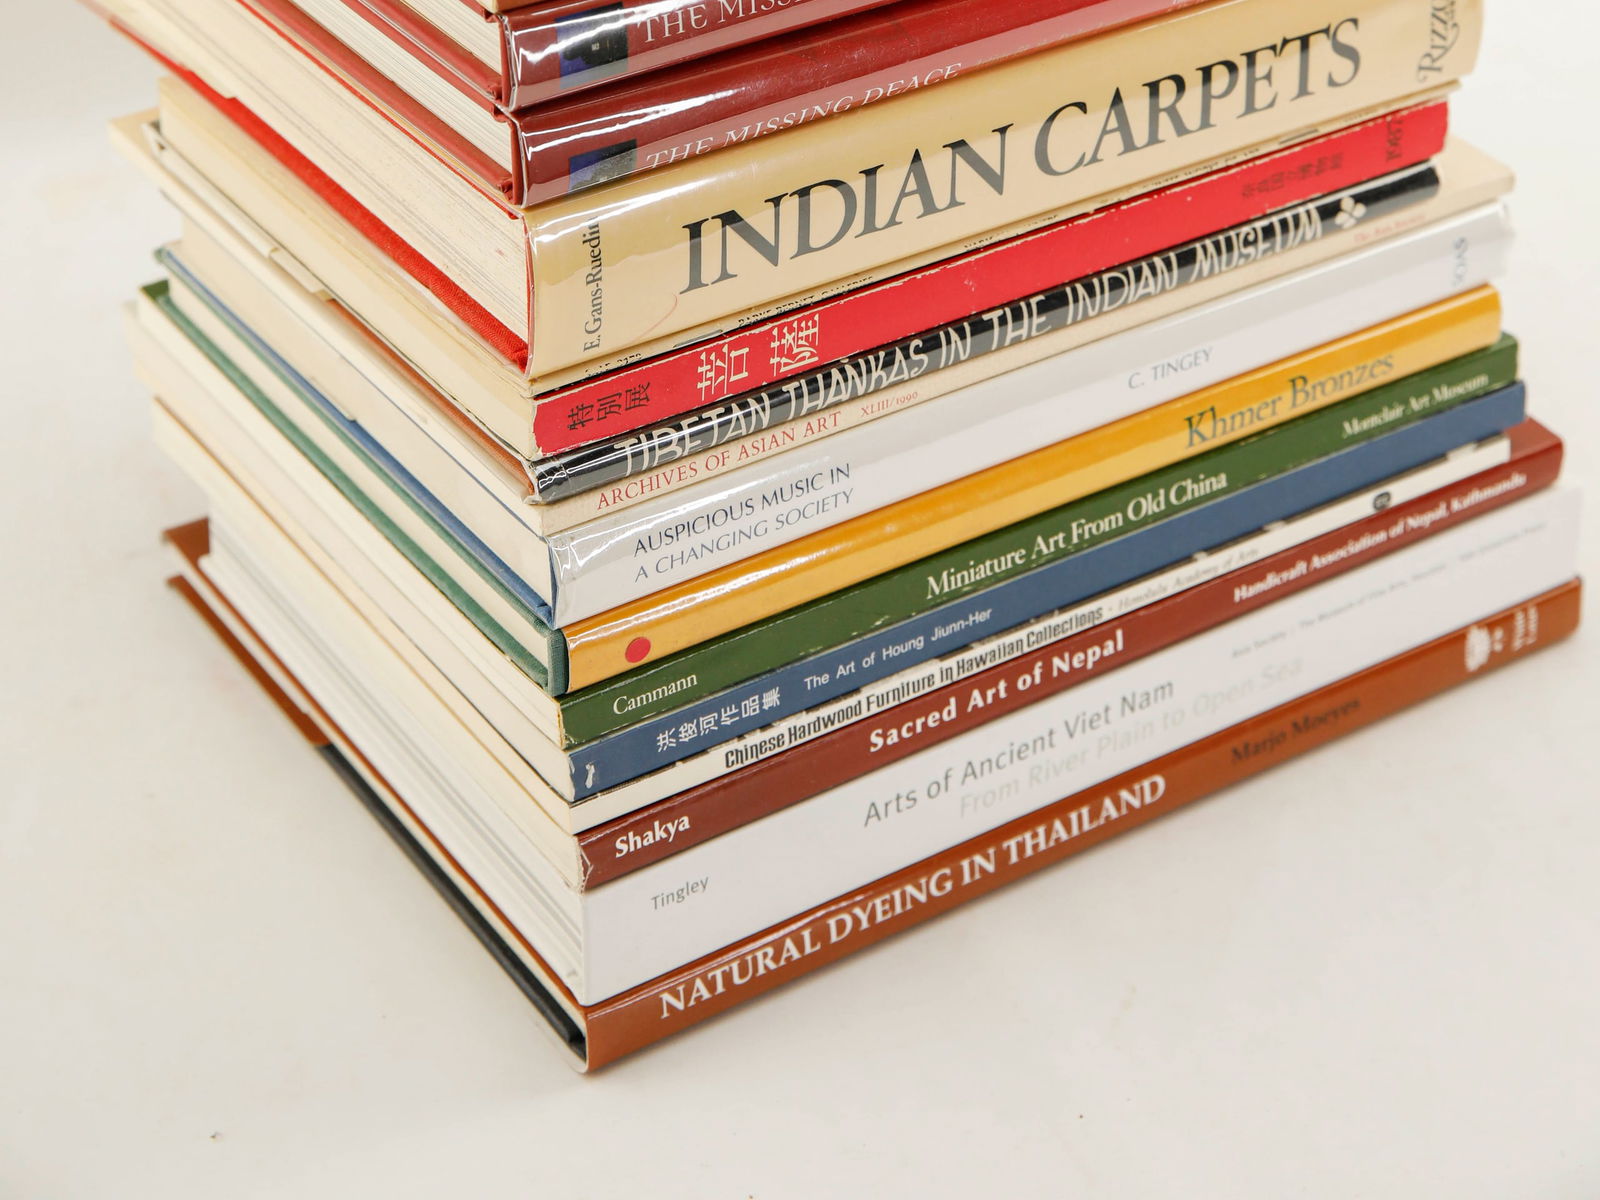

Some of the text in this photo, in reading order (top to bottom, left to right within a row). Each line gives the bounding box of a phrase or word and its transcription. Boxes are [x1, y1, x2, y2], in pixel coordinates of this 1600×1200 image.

[636, 4, 709, 45] THE
[646, 136, 714, 169] THE
[723, 96, 854, 144] MISSING
[678, 16, 1362, 296] INDIAN CARPETS
[581, 214, 602, 353] E. Gans-Ruedin
[566, 312, 819, 431] 特別展 菩薩
[613, 205, 1324, 478] TIBETAN THANKAS IN THE INDIAN MUSEUM
[1127, 346, 1214, 391] C. TINGEY
[596, 388, 920, 511] ARCHIVES OF ASIAN ART XLIII/1990
[1183, 353, 1397, 450] Khmer Bronzes
[1341, 372, 1491, 440] Montclair Art Museum
[633, 463, 851, 558] AUSPICIOUS MUSIC IN
[633, 487, 855, 584] A CHANGING SOCIETY
[926, 471, 1229, 601] Miniature Art From Old China
[1233, 557, 1309, 603] Handicraft
[1309, 528, 1389, 571] Association
[1388, 517, 1405, 536] of
[1450, 471, 1528, 513] Kathmandu
[612, 672, 699, 716] Cammann
[724, 605, 1104, 770] Chinese Hardwood Furniture in Hawaiian Collections
[804, 607, 993, 691] The Art of Houng Jiunn-Her
[869, 629, 1125, 753] Sacred Art of Nepal
[655, 686, 782, 753] 洪俊河作品集
[863, 680, 1176, 828] Arts of Ancient Viet Nam
[959, 657, 1304, 820] From River Plain to Open Sea
[1230, 732, 1288, 766] Marjo
[614, 814, 692, 859] Shakya
[650, 874, 710, 912] Tingley
[659, 773, 1168, 1020] NATURAL DYEING IN THAILAND
